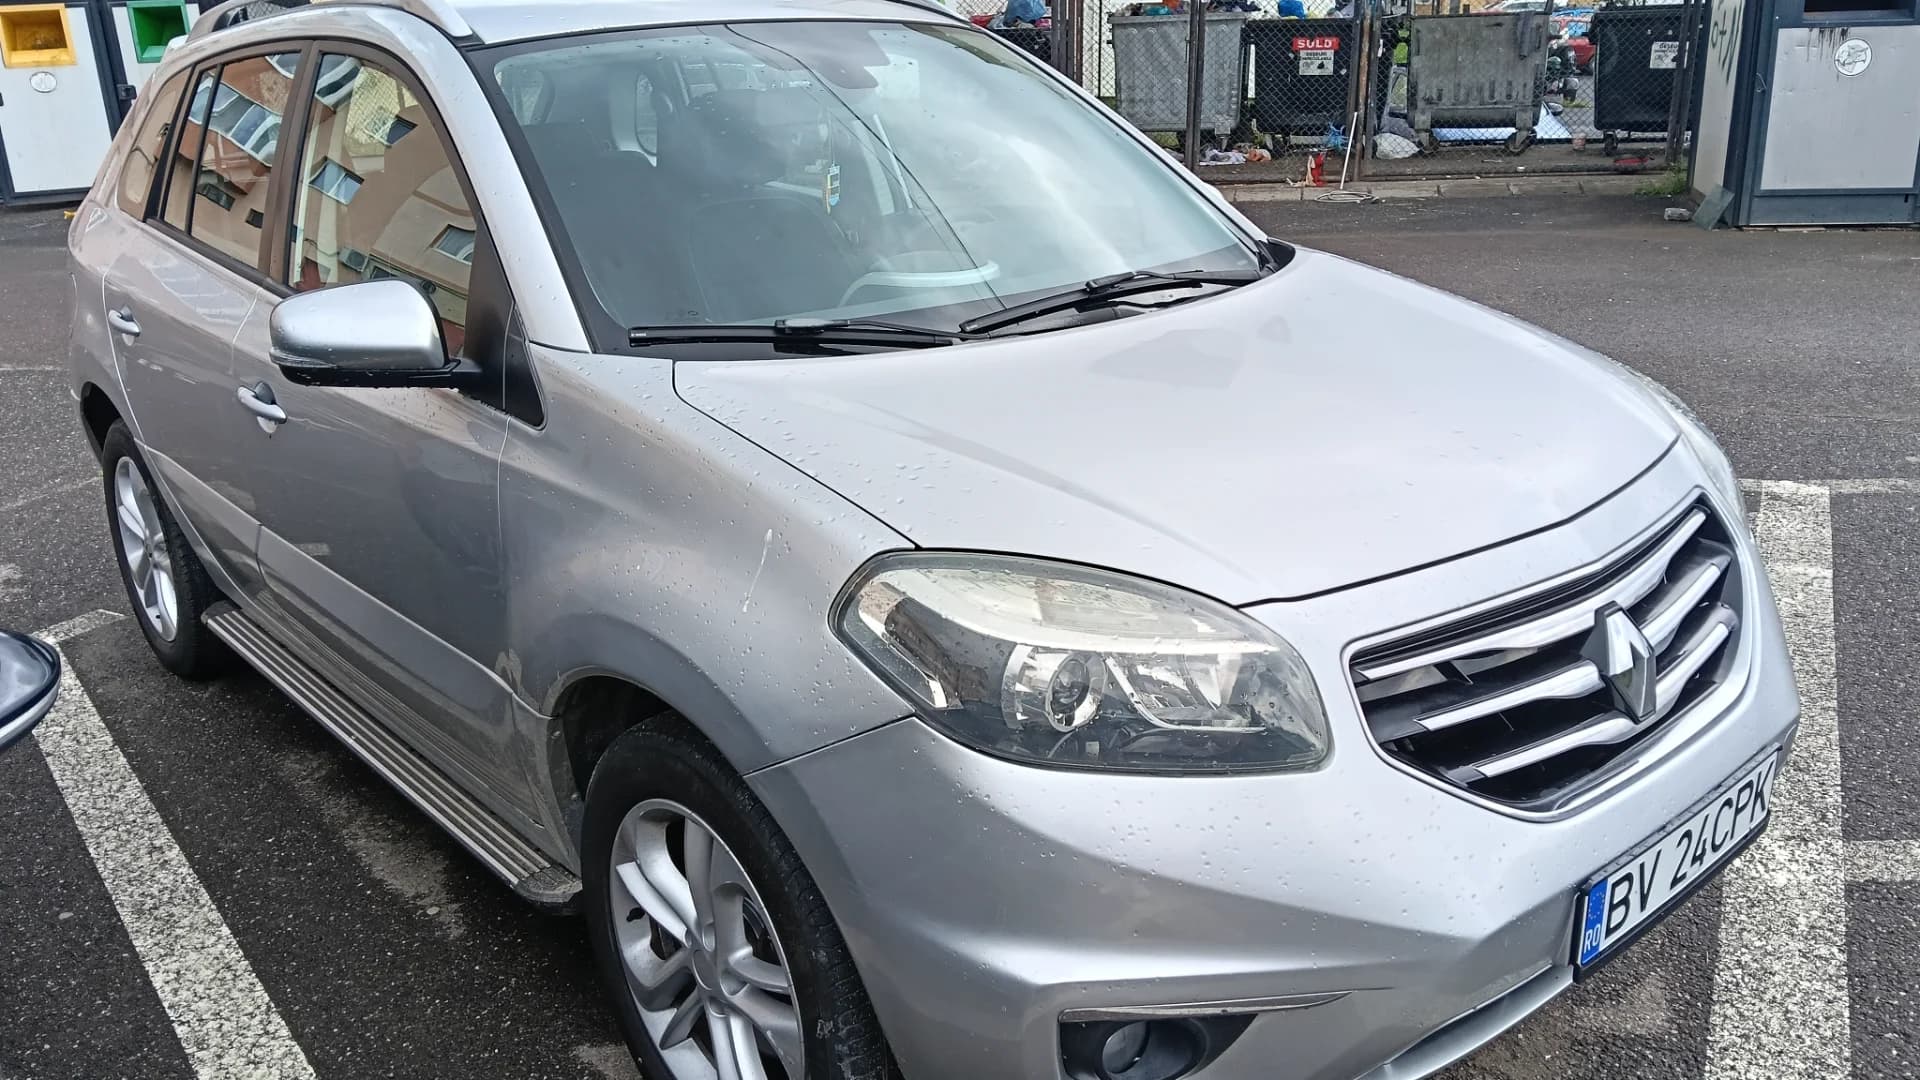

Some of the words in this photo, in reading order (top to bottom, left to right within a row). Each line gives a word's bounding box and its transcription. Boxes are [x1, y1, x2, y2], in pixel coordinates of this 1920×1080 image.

[1605, 849, 1662, 941] BV
[1669, 759, 1775, 890] 24CPK
[1584, 923, 1601, 954] RO
